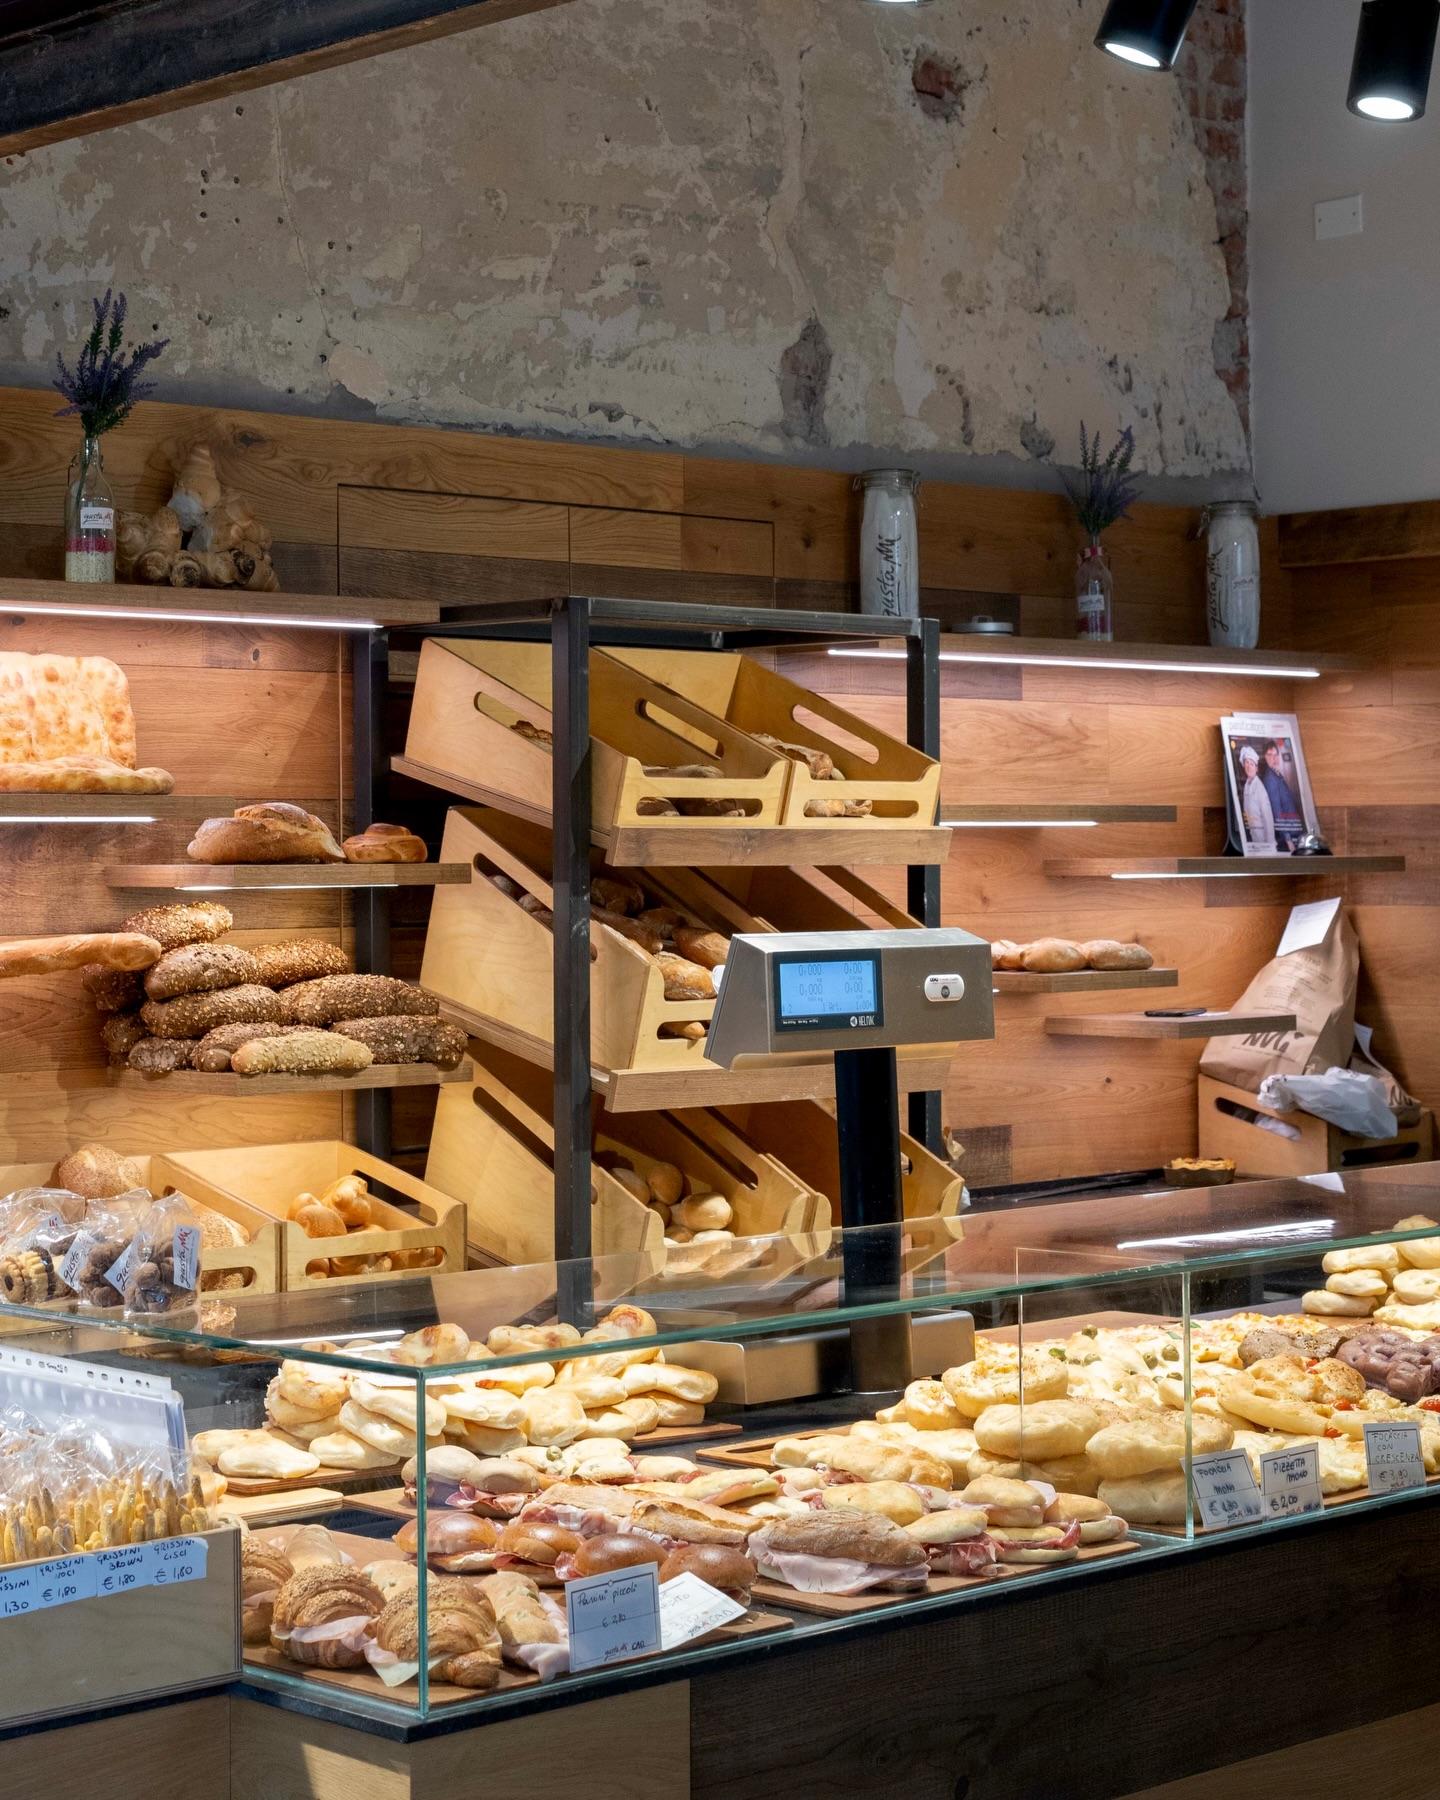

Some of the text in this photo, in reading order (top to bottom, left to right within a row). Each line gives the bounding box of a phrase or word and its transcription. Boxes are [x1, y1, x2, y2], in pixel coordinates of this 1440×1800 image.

[1376, 1443, 1393, 1452] CON
[1208, 1500, 1221, 1516] €
[1270, 1499, 1280, 1511] €
[153, 1540, 195, 1555] GRISSINI
[97, 1547, 140, 1565] GRISSINI
[109, 1555, 143, 1571] BROWN
[40, 1557, 84, 1576] GRISSINI
[102, 1576, 114, 1590] €
[154, 1568, 167, 1583] €
[41, 1586, 77, 1601] € 1,80
[577, 1582, 638, 1606] Panini piccoli
[4, 1601, 29, 1614] 1,30
